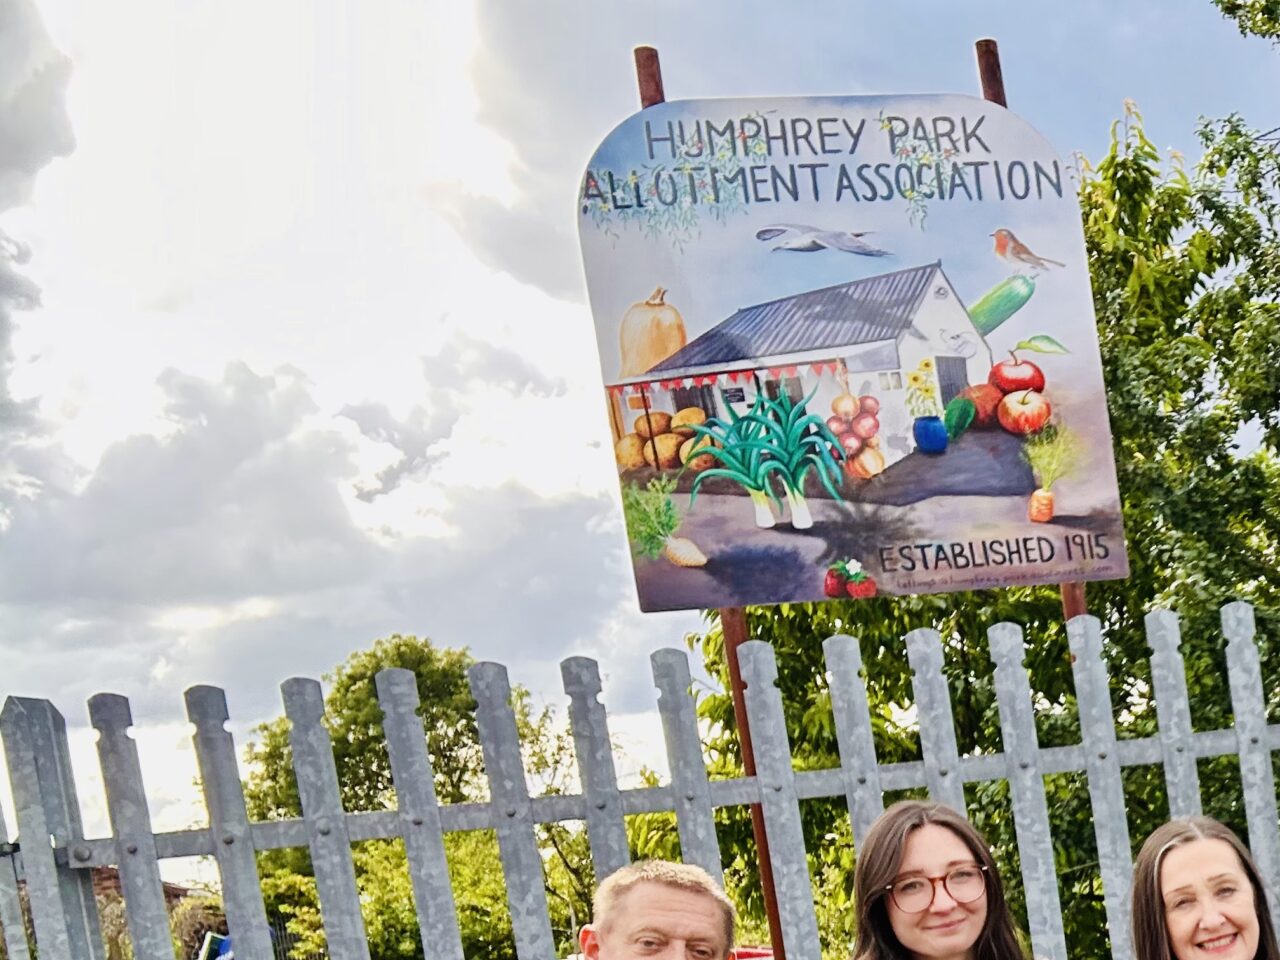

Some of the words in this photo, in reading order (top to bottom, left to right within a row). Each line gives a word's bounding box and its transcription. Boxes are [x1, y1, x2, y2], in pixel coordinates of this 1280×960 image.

[645, 117, 867, 159] HUMPHREY
[886, 115, 992, 153] PARK
[583, 163, 829, 212] ALLOTMENT
[836, 160, 1063, 202] ASSOCIATION
[879, 537, 1055, 573] ESTABLISHED
[1064, 533, 1110, 561] 1915
